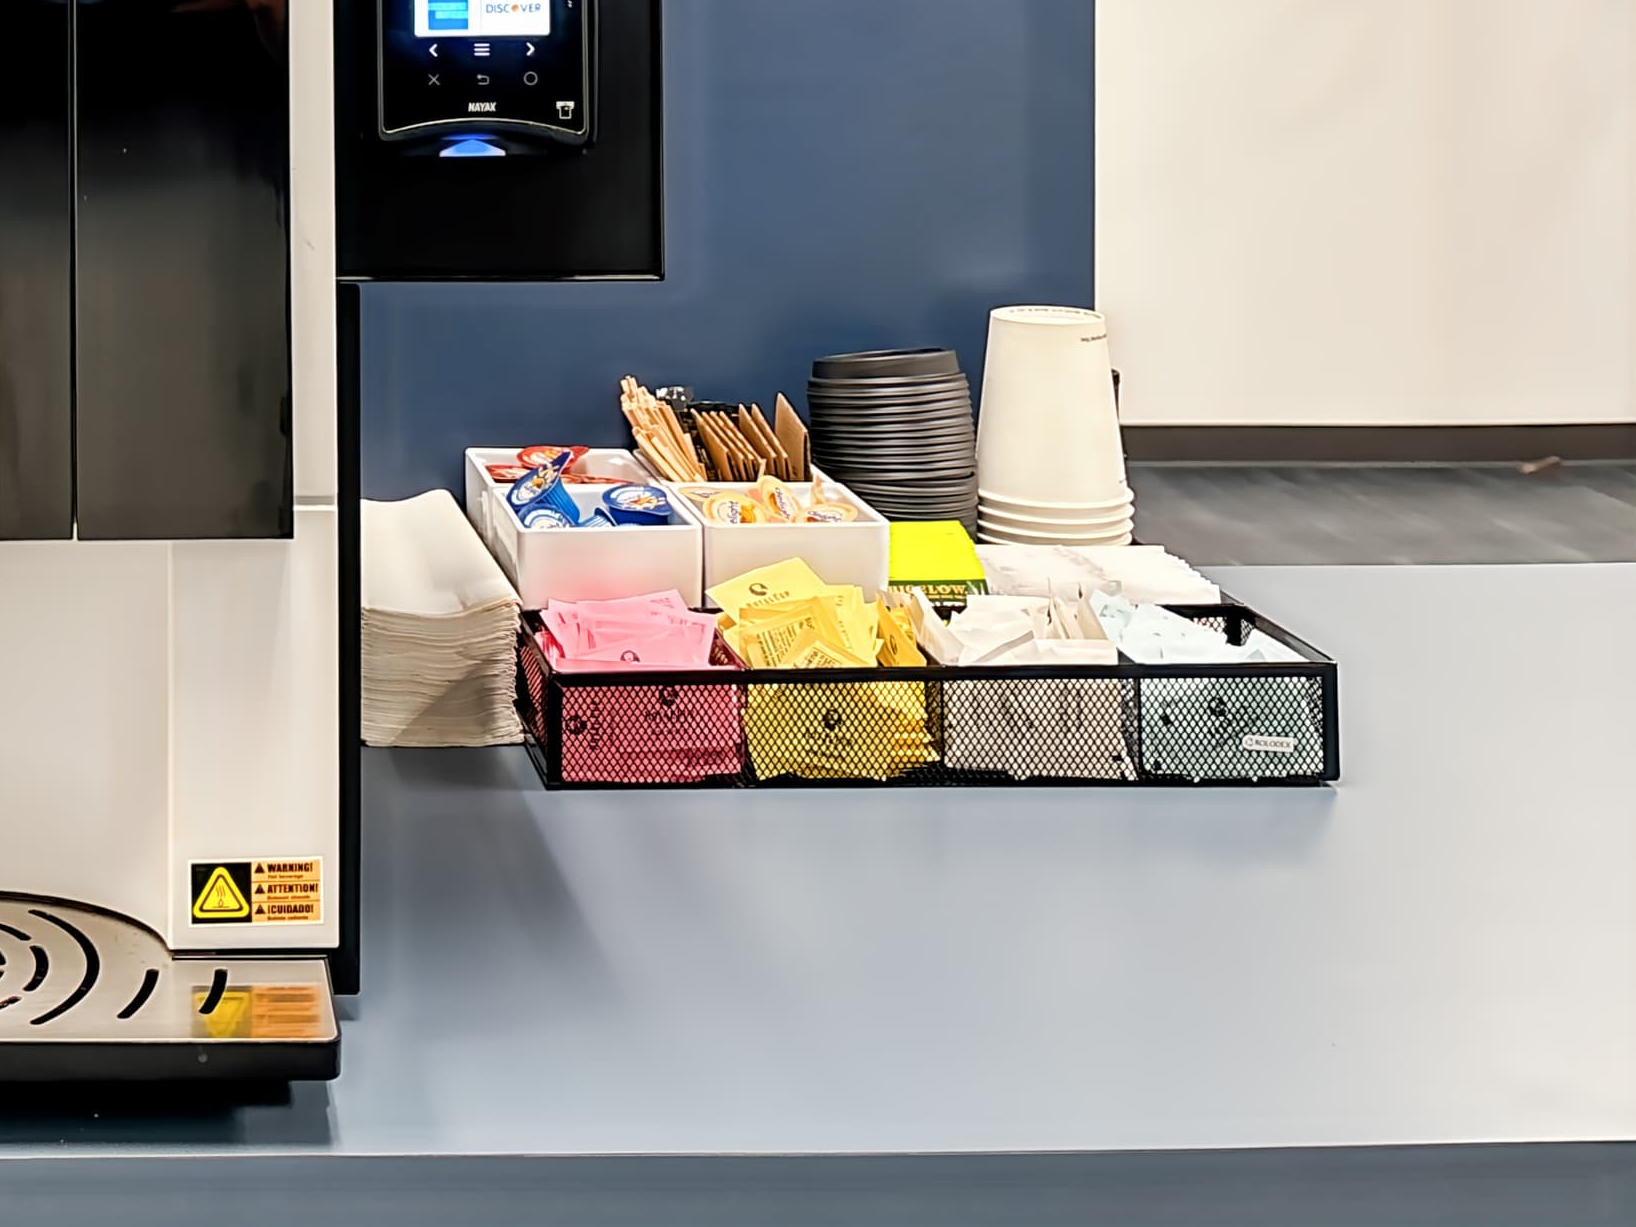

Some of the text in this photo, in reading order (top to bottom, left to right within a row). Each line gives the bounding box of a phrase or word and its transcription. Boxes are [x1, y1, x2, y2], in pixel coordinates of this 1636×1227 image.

[485, 3, 541, 14] DISCOVER
[267, 863, 313, 872] WARNING!
[267, 883, 318, 893] ATTENTION!
